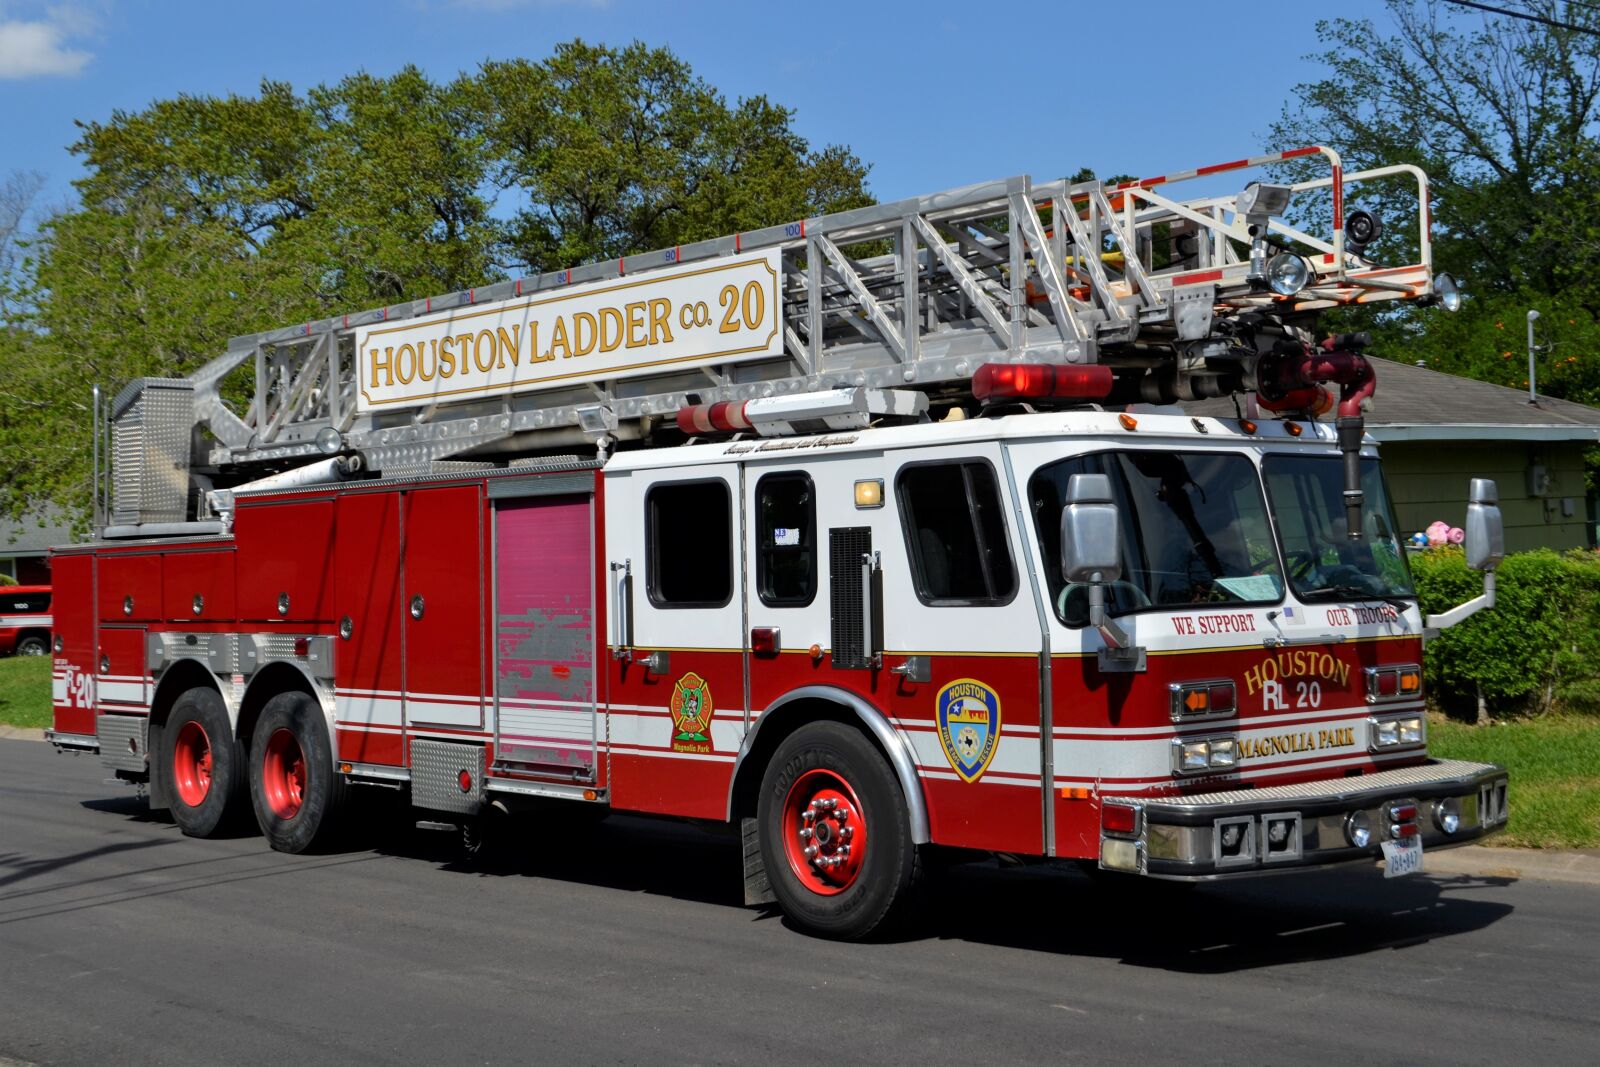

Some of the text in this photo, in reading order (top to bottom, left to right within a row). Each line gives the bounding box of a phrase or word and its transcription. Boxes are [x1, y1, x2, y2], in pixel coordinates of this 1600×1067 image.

[785, 223, 801, 237] 100
[665, 249, 676, 261] 90
[369, 280, 765, 388] HOUSTON LADDER CO. 20
[1171, 613, 1257, 635] WE SUPPORT
[1326, 605, 1399, 627] OUR TROOPS
[1243, 650, 1352, 696] HOUSTON
[949, 683, 987, 702] HOUSTON
[1262, 680, 1322, 711] RL 20
[697, 744, 710, 753] Park
[1236, 726, 1356, 760] MAGNOLIA PARK
